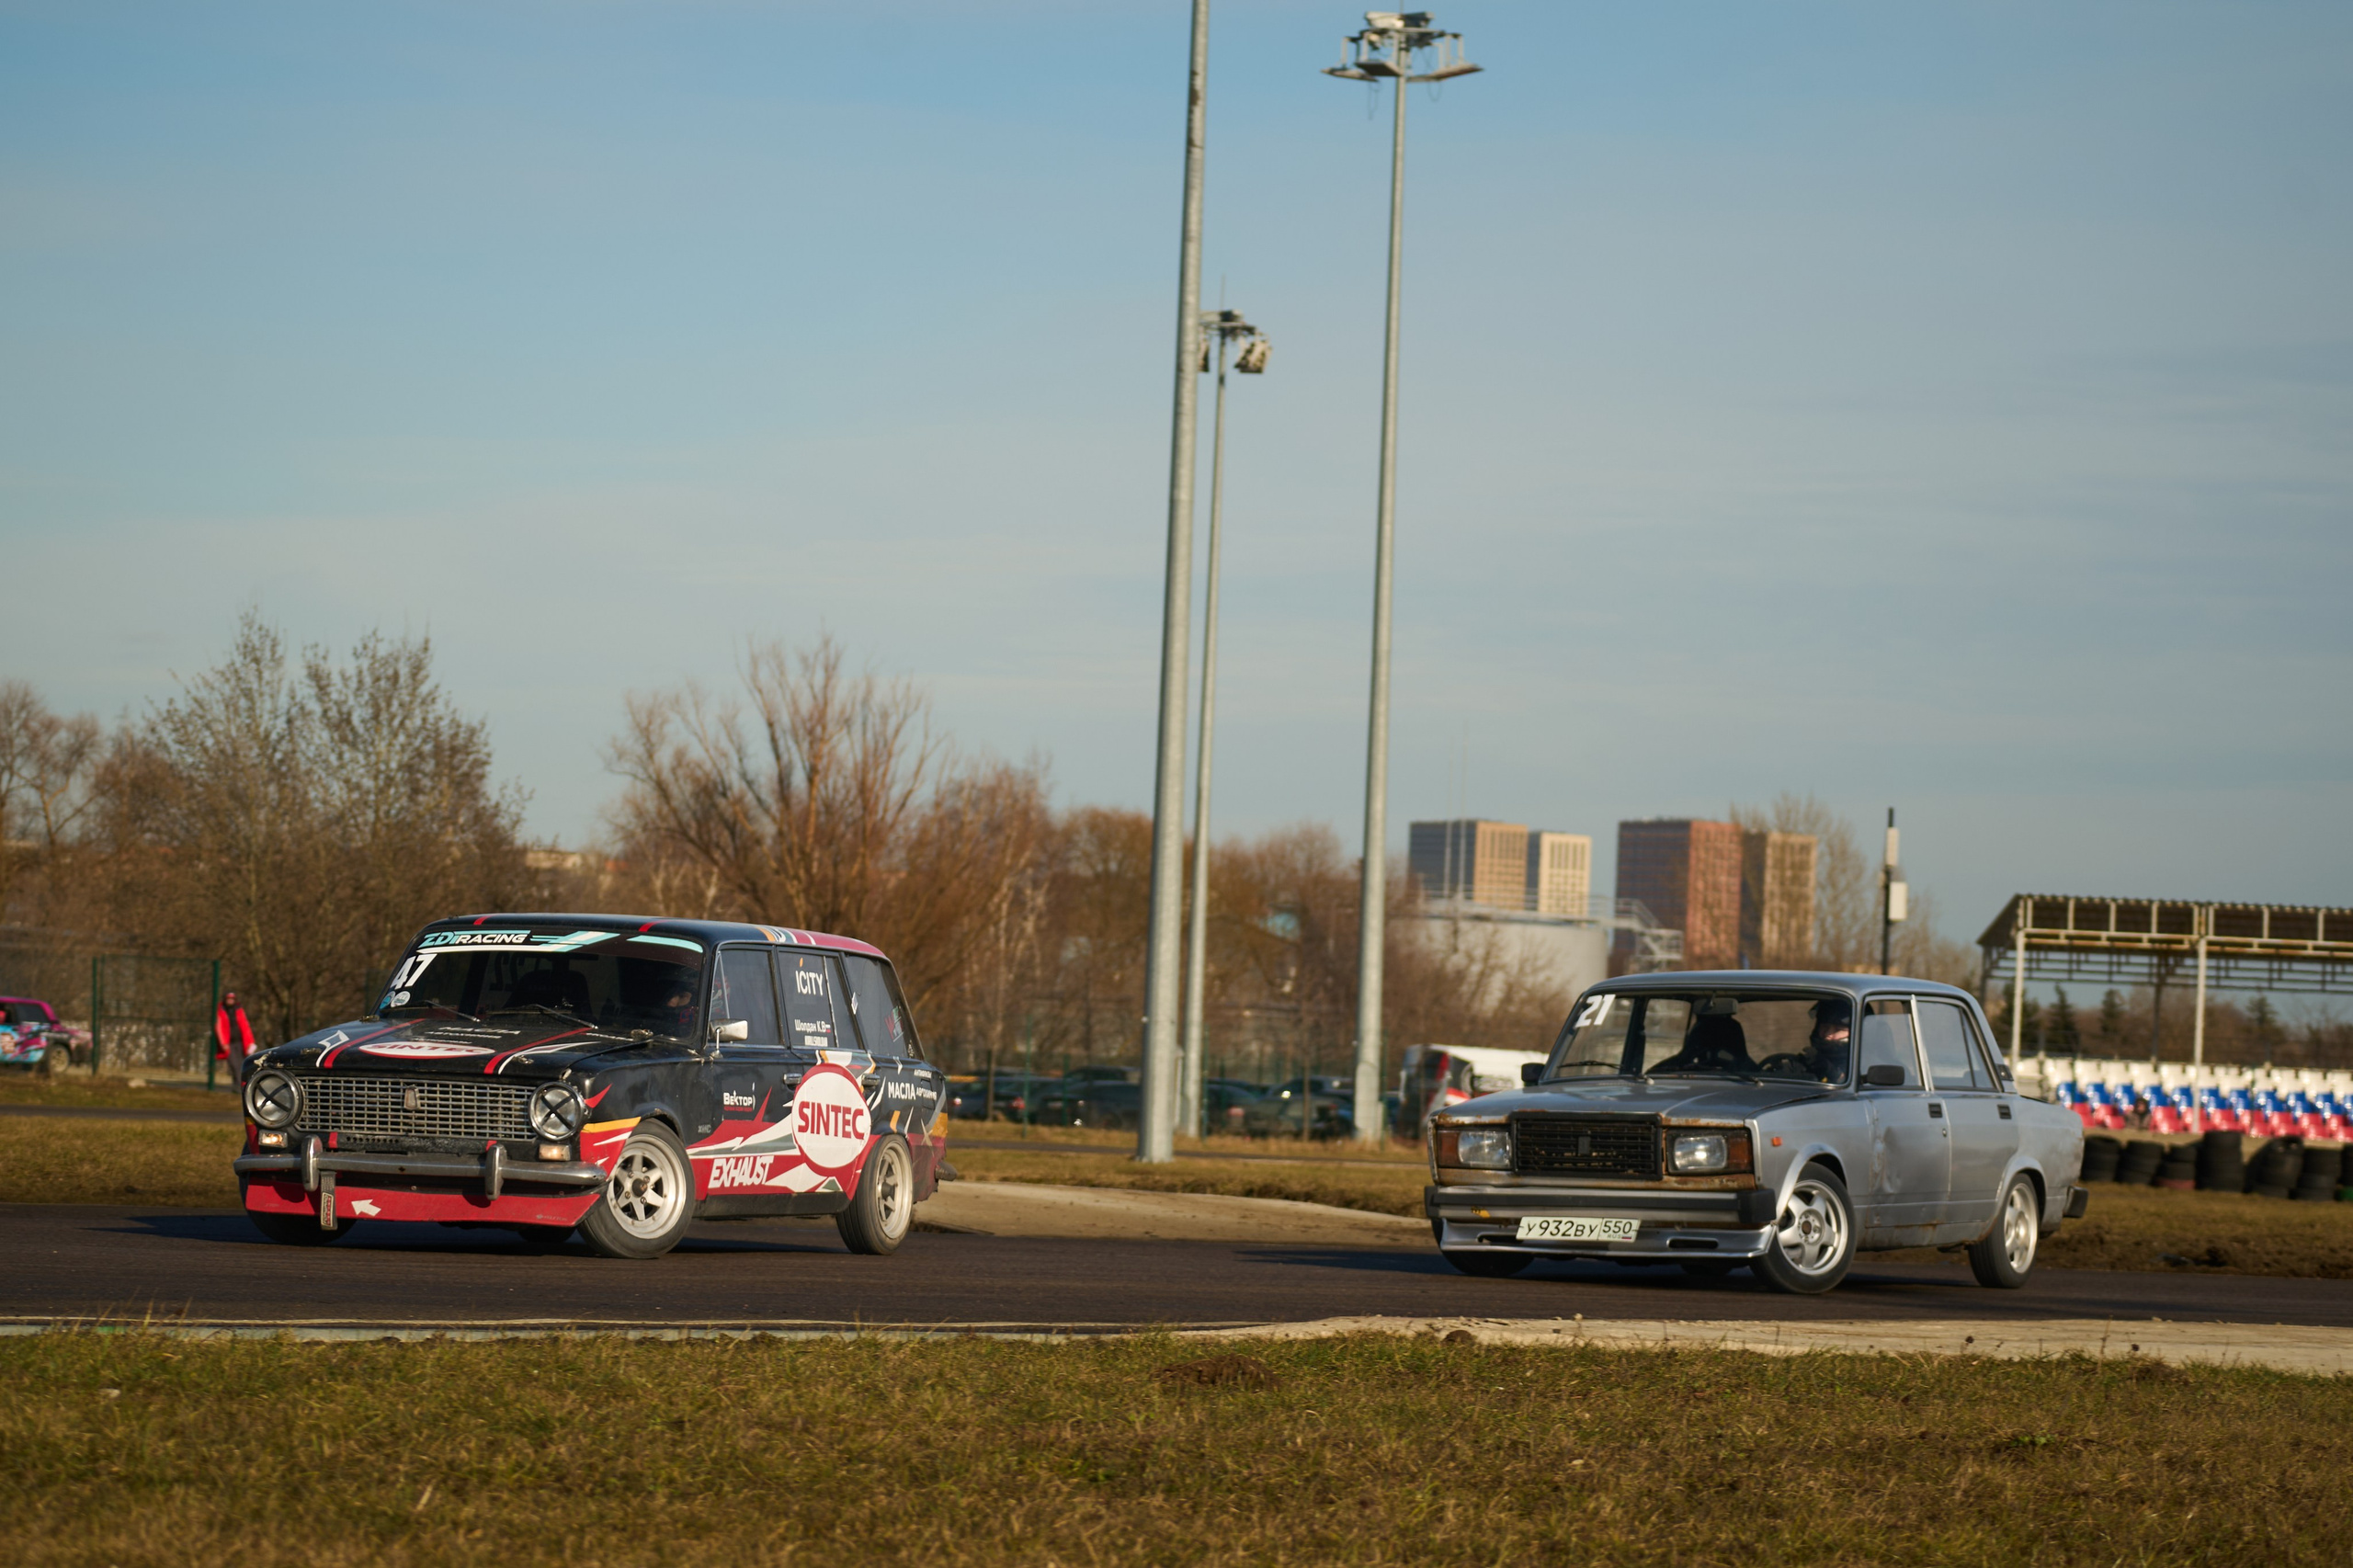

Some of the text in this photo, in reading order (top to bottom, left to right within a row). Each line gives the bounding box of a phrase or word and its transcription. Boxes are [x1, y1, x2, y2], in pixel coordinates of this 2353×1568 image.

[390, 953, 438, 990] 47
[1574, 994, 1616, 1028] 21
[369, 1043, 488, 1054] SINTEC
[888, 1081, 916, 1101] МАСЛА
[798, 1101, 865, 1140] SINTEC
[708, 1155, 774, 1189] EXHAUST
[1602, 1220, 1632, 1234] 550
